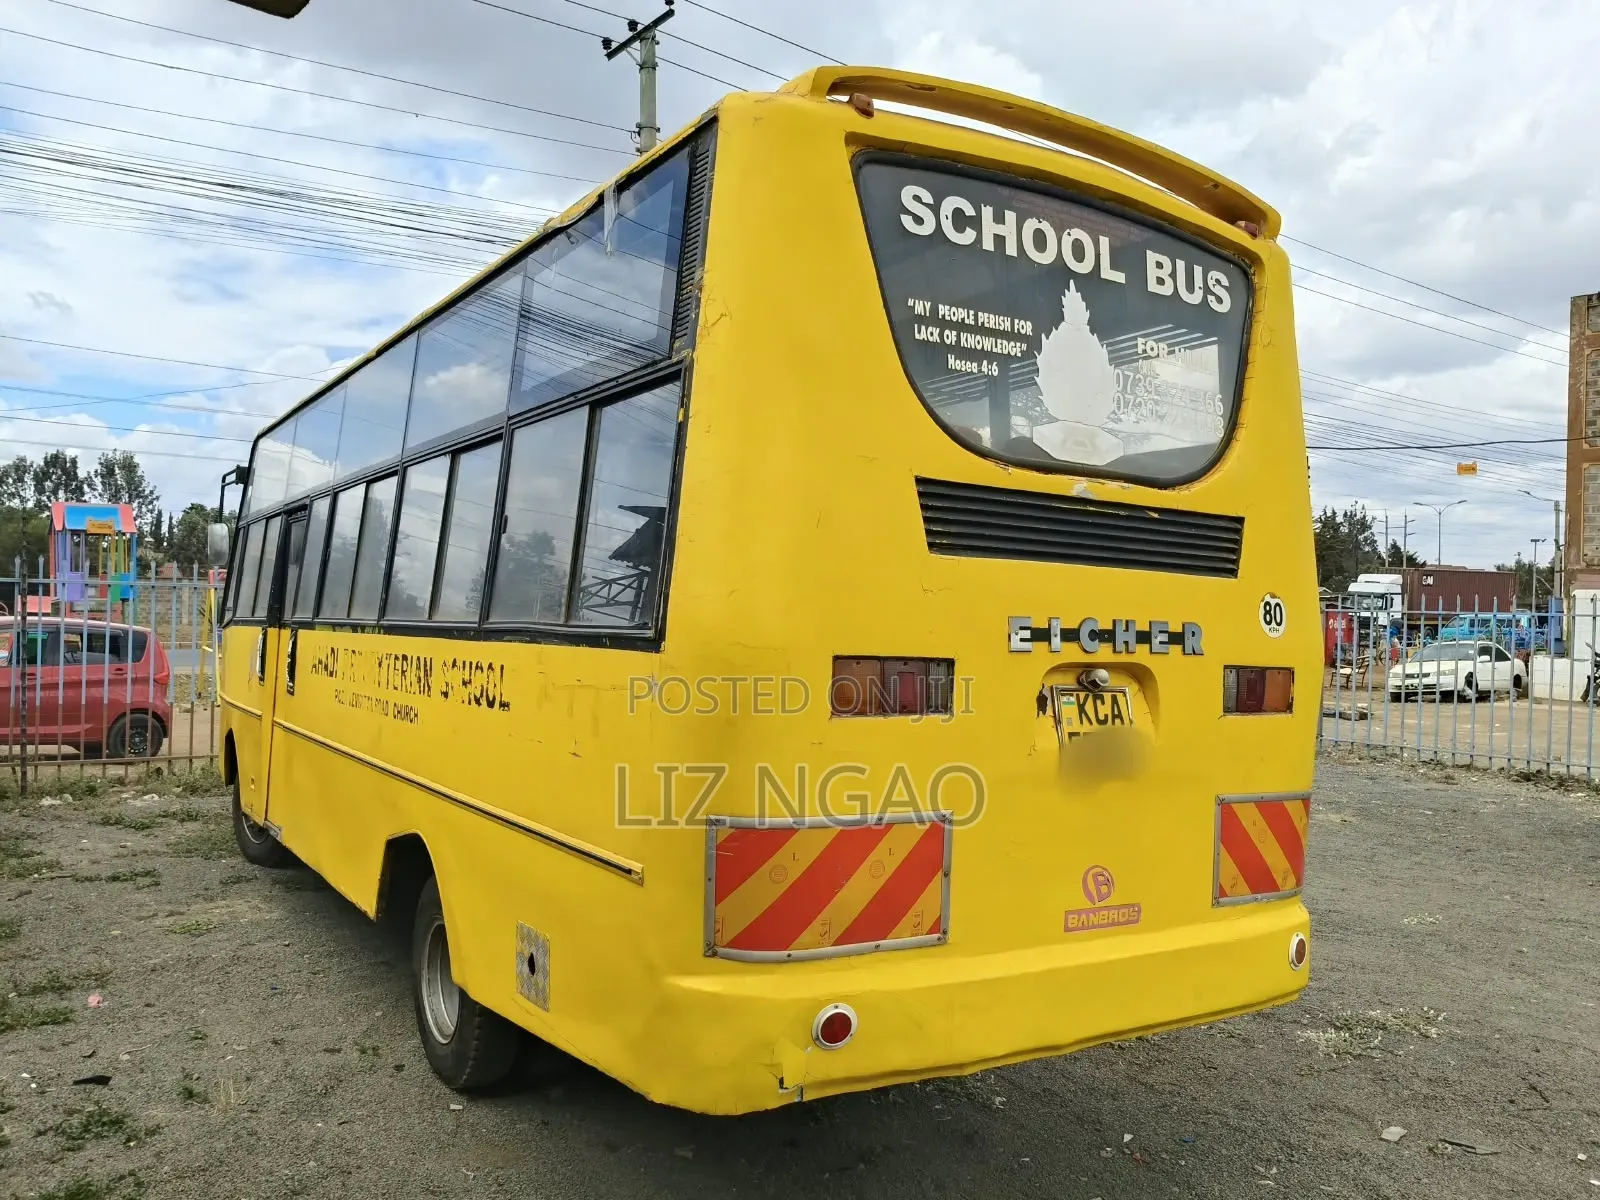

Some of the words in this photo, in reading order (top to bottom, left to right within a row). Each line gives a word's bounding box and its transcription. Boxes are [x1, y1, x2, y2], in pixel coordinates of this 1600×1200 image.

[900, 185, 1125, 284] SCHOOL
[1146, 250, 1231, 313] BUS
[938, 304, 975, 325] PEOPLE
[978, 312, 1011, 332] PERISH
[1014, 319, 1033, 336] FOR
[914, 324, 940, 343] LACK
[943, 330, 957, 345] OF
[1137, 338, 1168, 360] FOR
[947, 354, 978, 373] Hosea
[981, 360, 999, 377] 4:6
[1263, 601, 1283, 627] 80
[1008, 616, 1204, 655] EICHER
[392, 702, 419, 725] CHURCH
[1075, 693, 1125, 726] KCA
